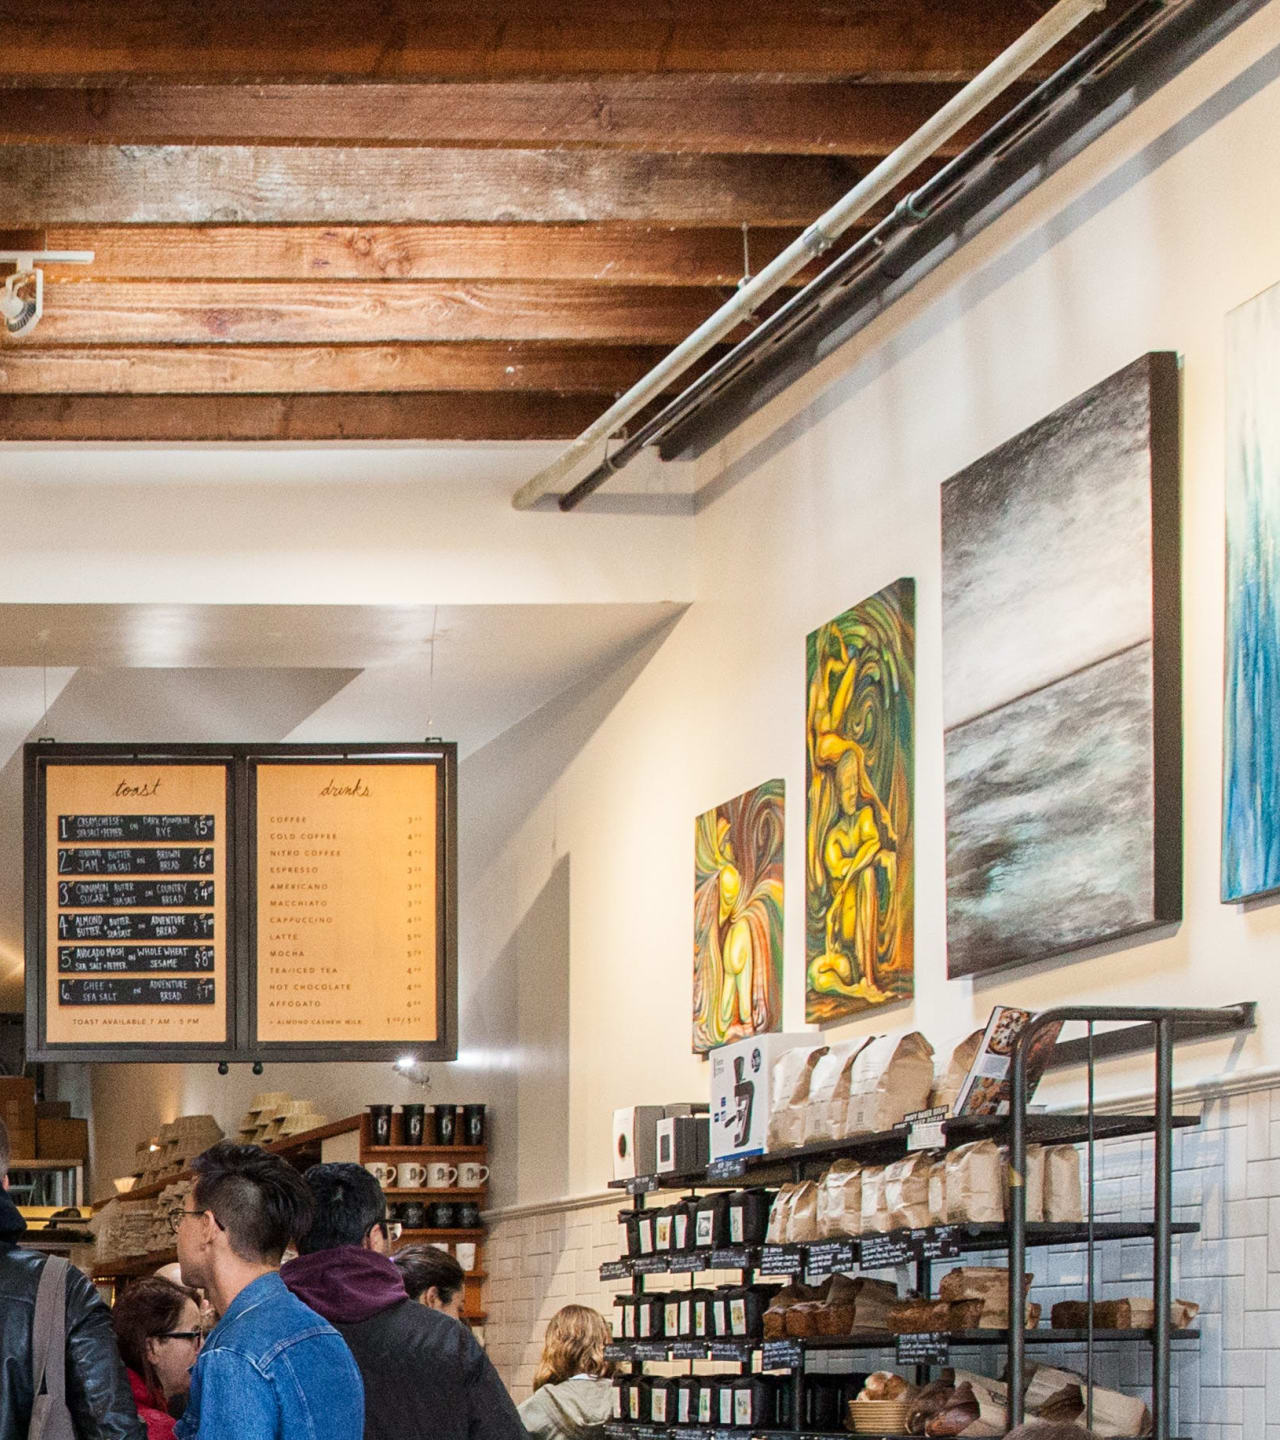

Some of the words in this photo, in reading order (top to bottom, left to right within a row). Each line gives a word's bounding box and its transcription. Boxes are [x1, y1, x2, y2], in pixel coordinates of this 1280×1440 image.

[113, 777, 161, 797] toast
[320, 777, 372, 797] drinks
[270, 816, 307, 824] COFFEE
[62, 819, 68, 838] 1
[155, 826, 171, 837] RYE
[270, 833, 296, 841] COLD
[300, 833, 337, 841] COFFEE
[108, 850, 131, 860] BUTTER
[58, 850, 72, 872] 2
[77, 859, 99, 872] JAM
[159, 860, 181, 871] BREAD
[270, 866, 319, 874] ESPRESSO
[76, 882, 109, 894] CINNAMON
[156, 883, 187, 895] COUNTRY
[79, 894, 104, 905] SUGAR
[161, 894, 184, 904] BREAD
[76, 915, 103, 927] ALMOND
[109, 915, 131, 927] BUTTER
[150, 915, 187, 926] ADVENTURE
[269, 916, 333, 924] CAPPUCCINO
[59, 915, 69, 937] 4
[155, 925, 178, 936] BREAD
[76, 926, 102, 938] BUTTER
[269, 933, 298, 941] LATTE
[76, 947, 105, 959] AVOCADO
[105, 947, 125, 958] MASH
[136, 947, 163, 957] WHOLE
[163, 947, 188, 957] WHEAT
[61, 949, 71, 968] 5
[150, 958, 178, 969] SESAME
[88, 960, 102, 970] SALT
[82, 980, 105, 992] GHEE
[149, 979, 188, 991] ADVENTURE
[293, 983, 351, 991] CHOCOLATE
[81, 992, 98, 1002] SEA
[99, 992, 118, 1001] SALT
[159, 991, 182, 1002] BREAD
[269, 1000, 321, 1008] AFFOGATO
